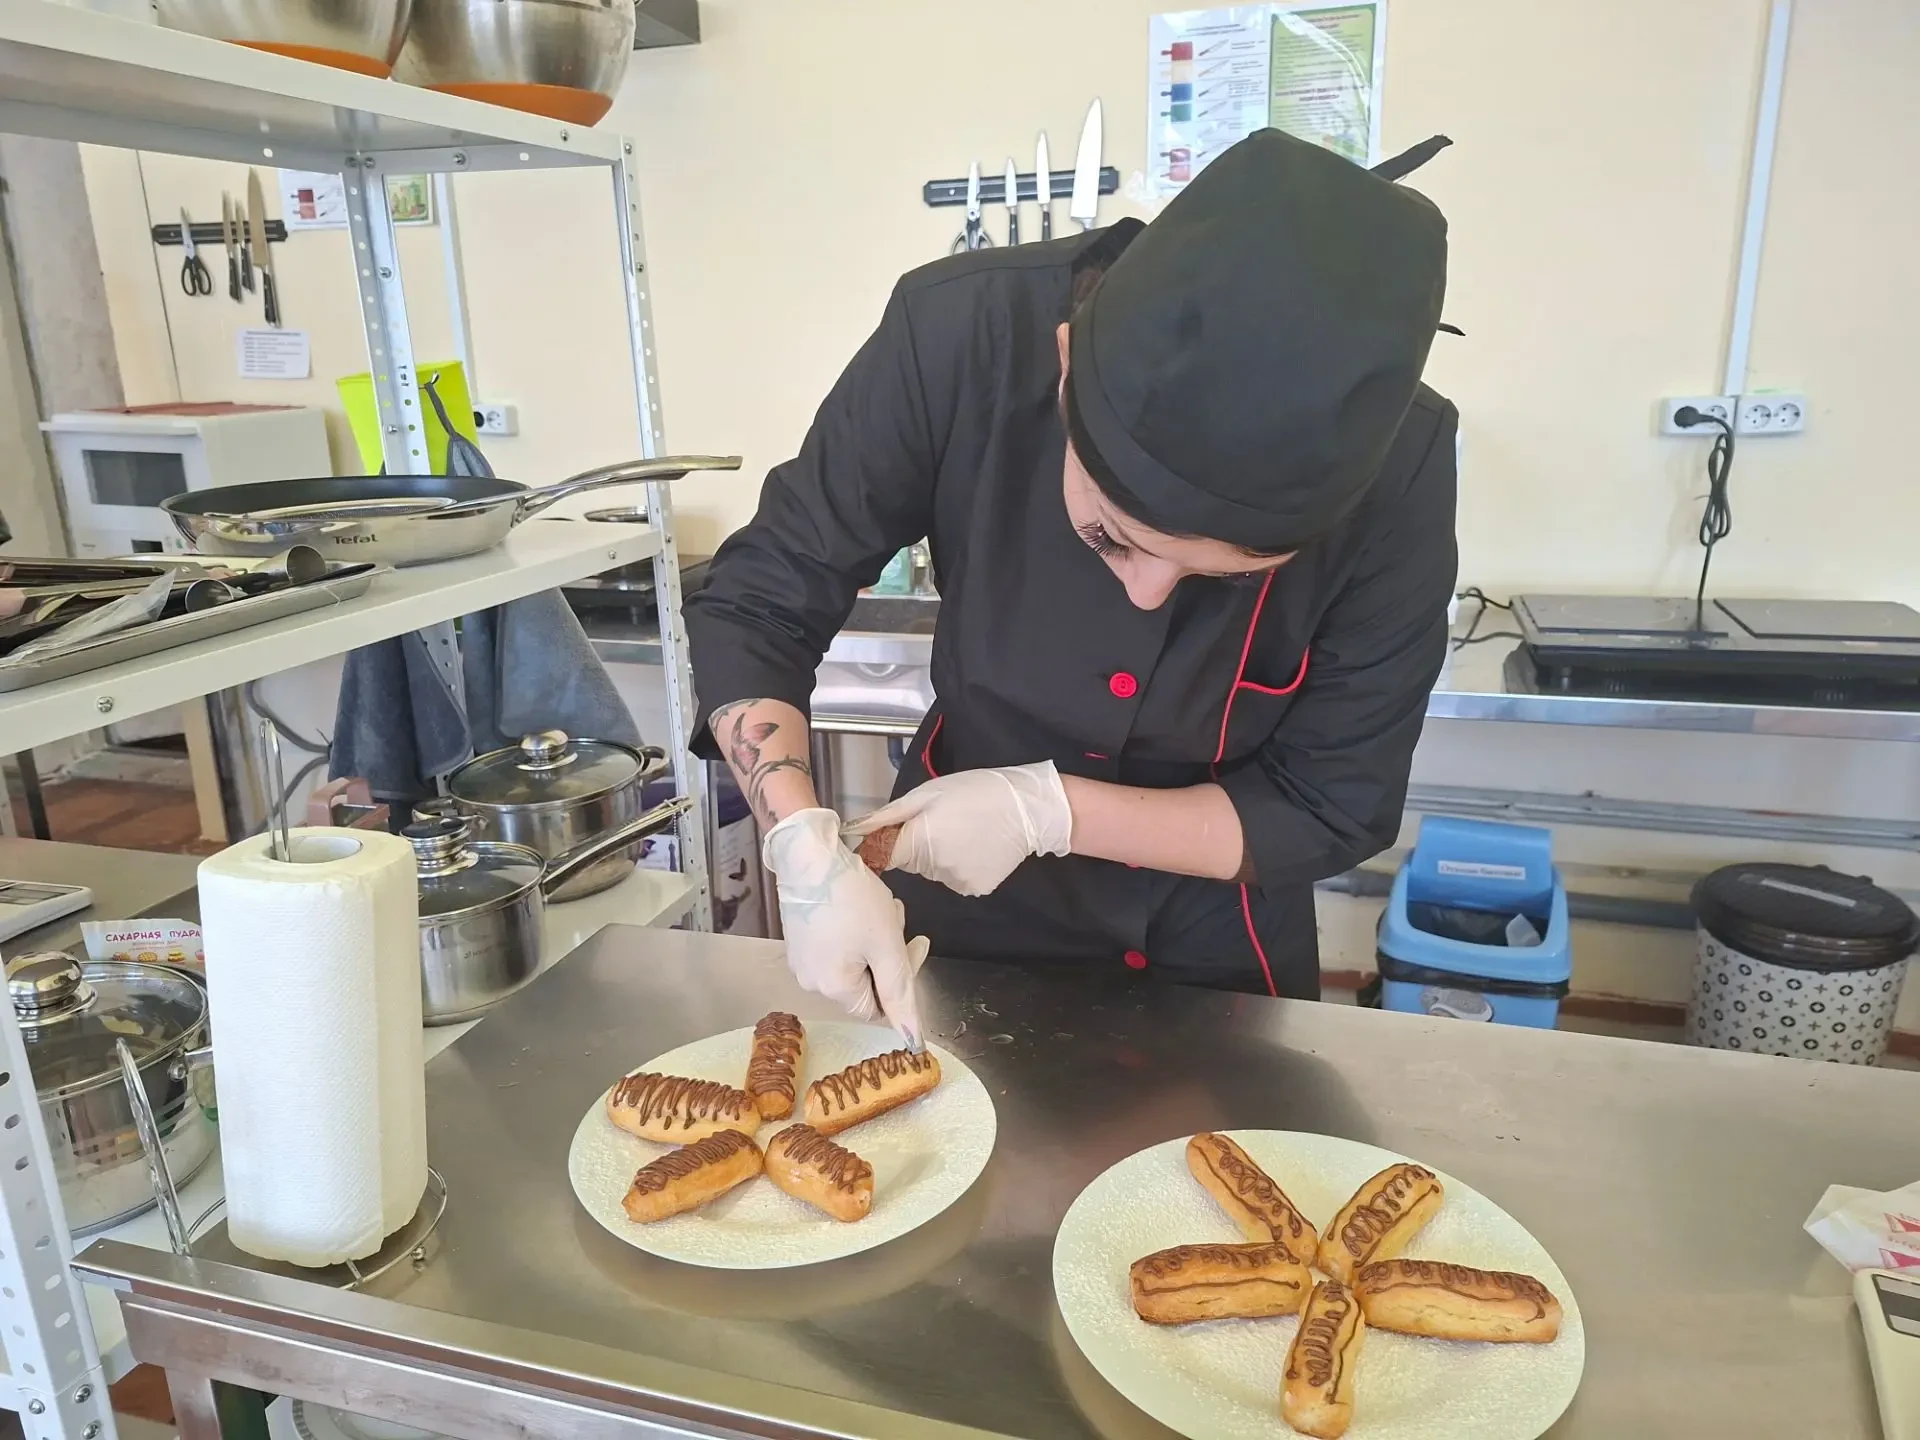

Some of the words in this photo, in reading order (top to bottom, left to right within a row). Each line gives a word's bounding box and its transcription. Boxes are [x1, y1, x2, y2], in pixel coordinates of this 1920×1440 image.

[332, 534, 379, 545] Tefal
[105, 931, 161, 942] САХАРНАЯ
[169, 930, 201, 938] ПУДРА
